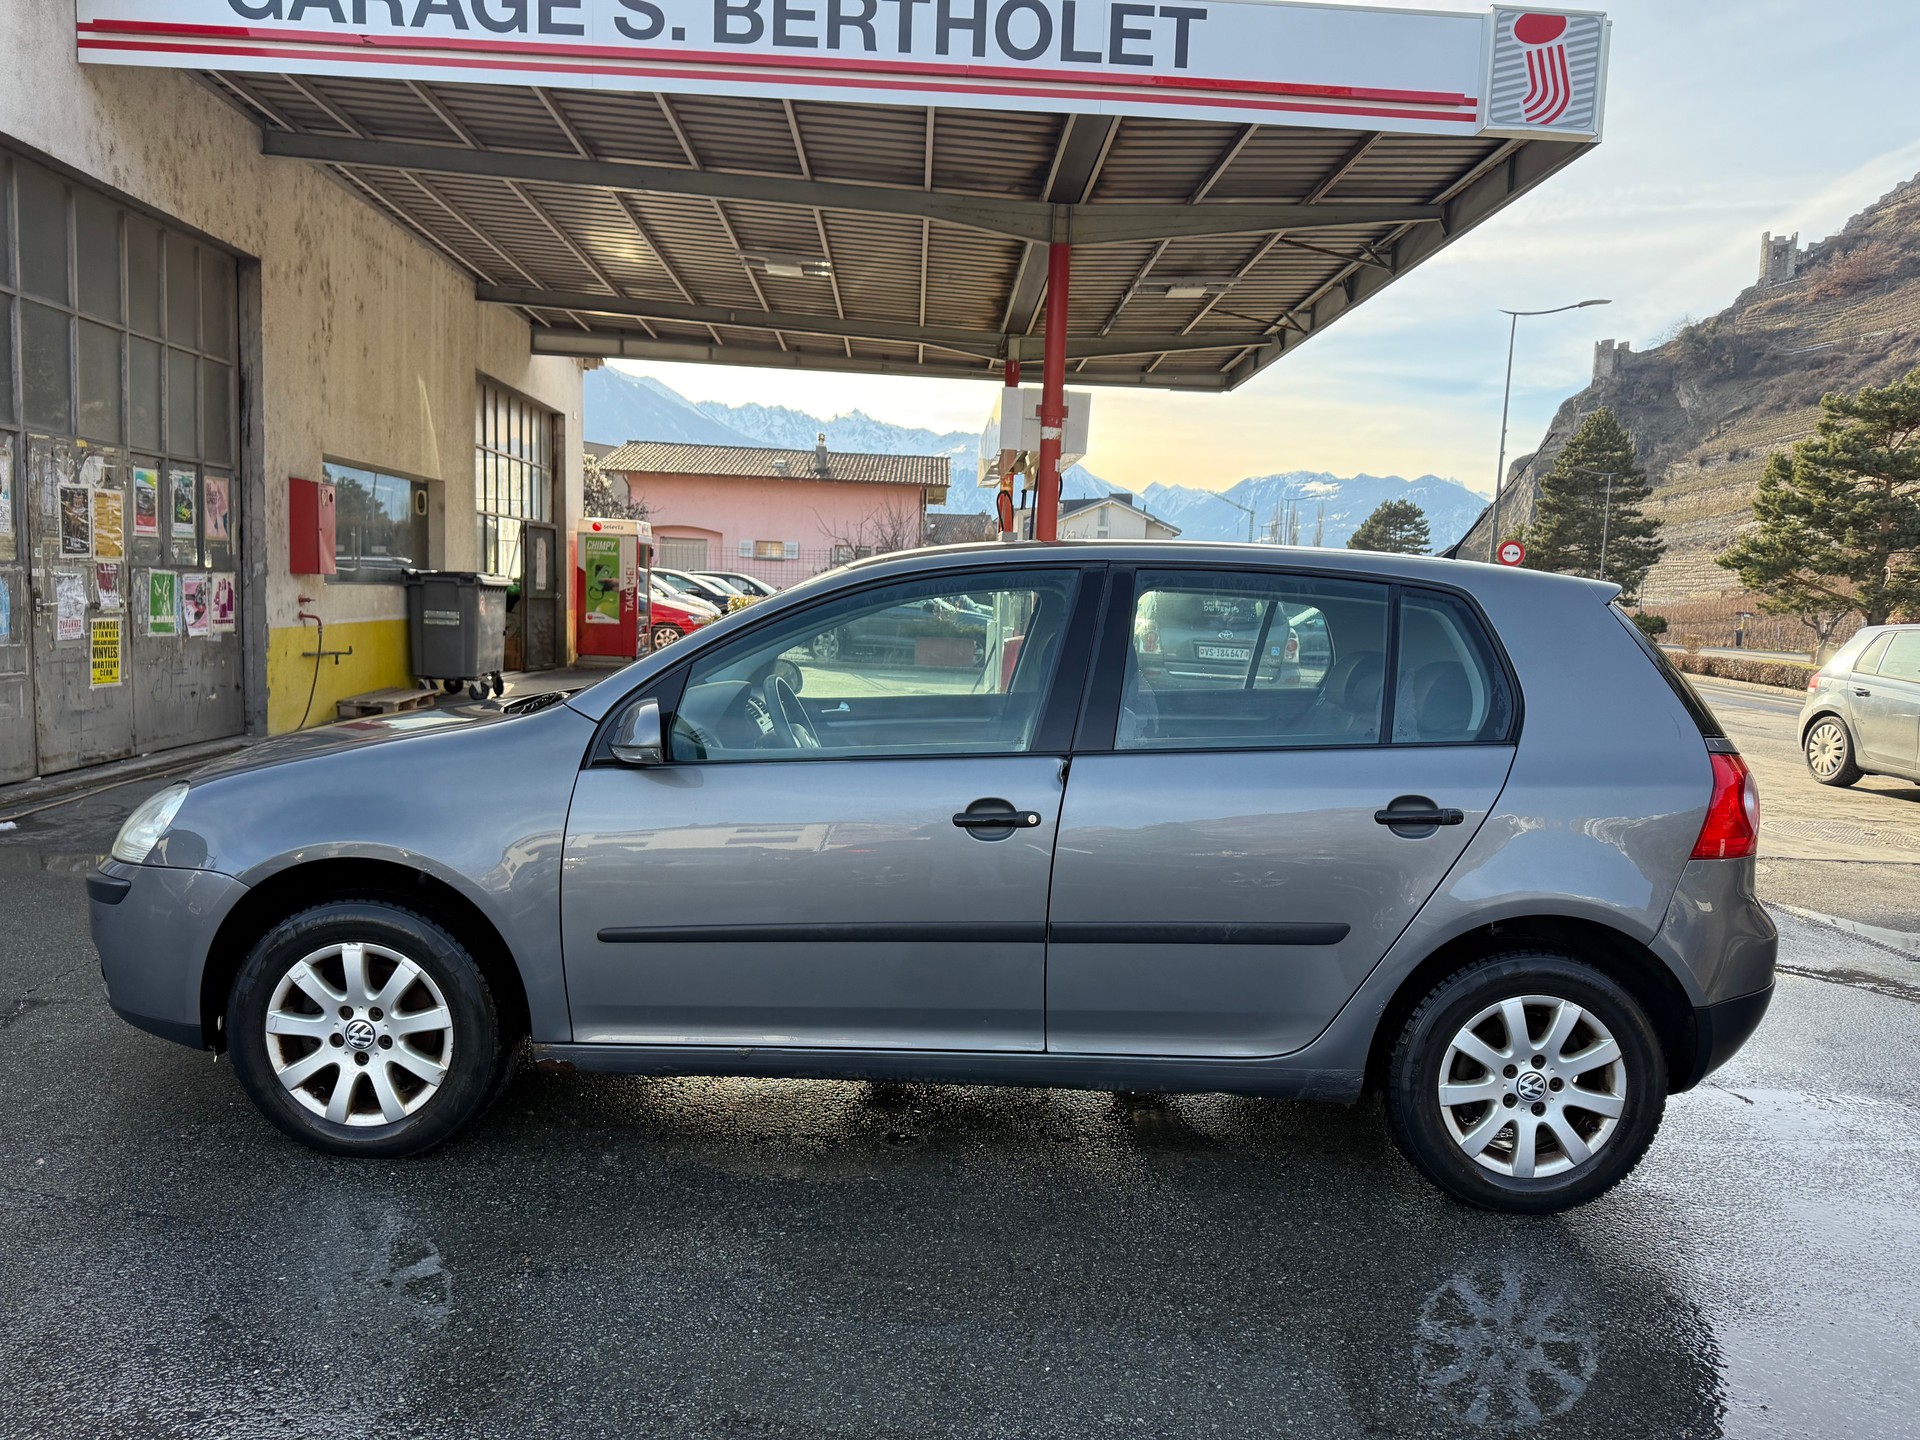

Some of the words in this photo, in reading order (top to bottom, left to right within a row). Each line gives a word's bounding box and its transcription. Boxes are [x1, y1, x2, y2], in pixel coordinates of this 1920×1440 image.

[713, 0, 1208, 69] BERTHOLET
[603, 523, 624, 531] selecta
[587, 540, 616, 551] CHIMPY
[625, 587, 635, 613] TAKE
[93, 621, 119, 630] DIMANCHE
[98, 630, 119, 638] JANVIER
[92, 646, 118, 659] VINYLES
[92, 660, 119, 669] MARTIGNY
